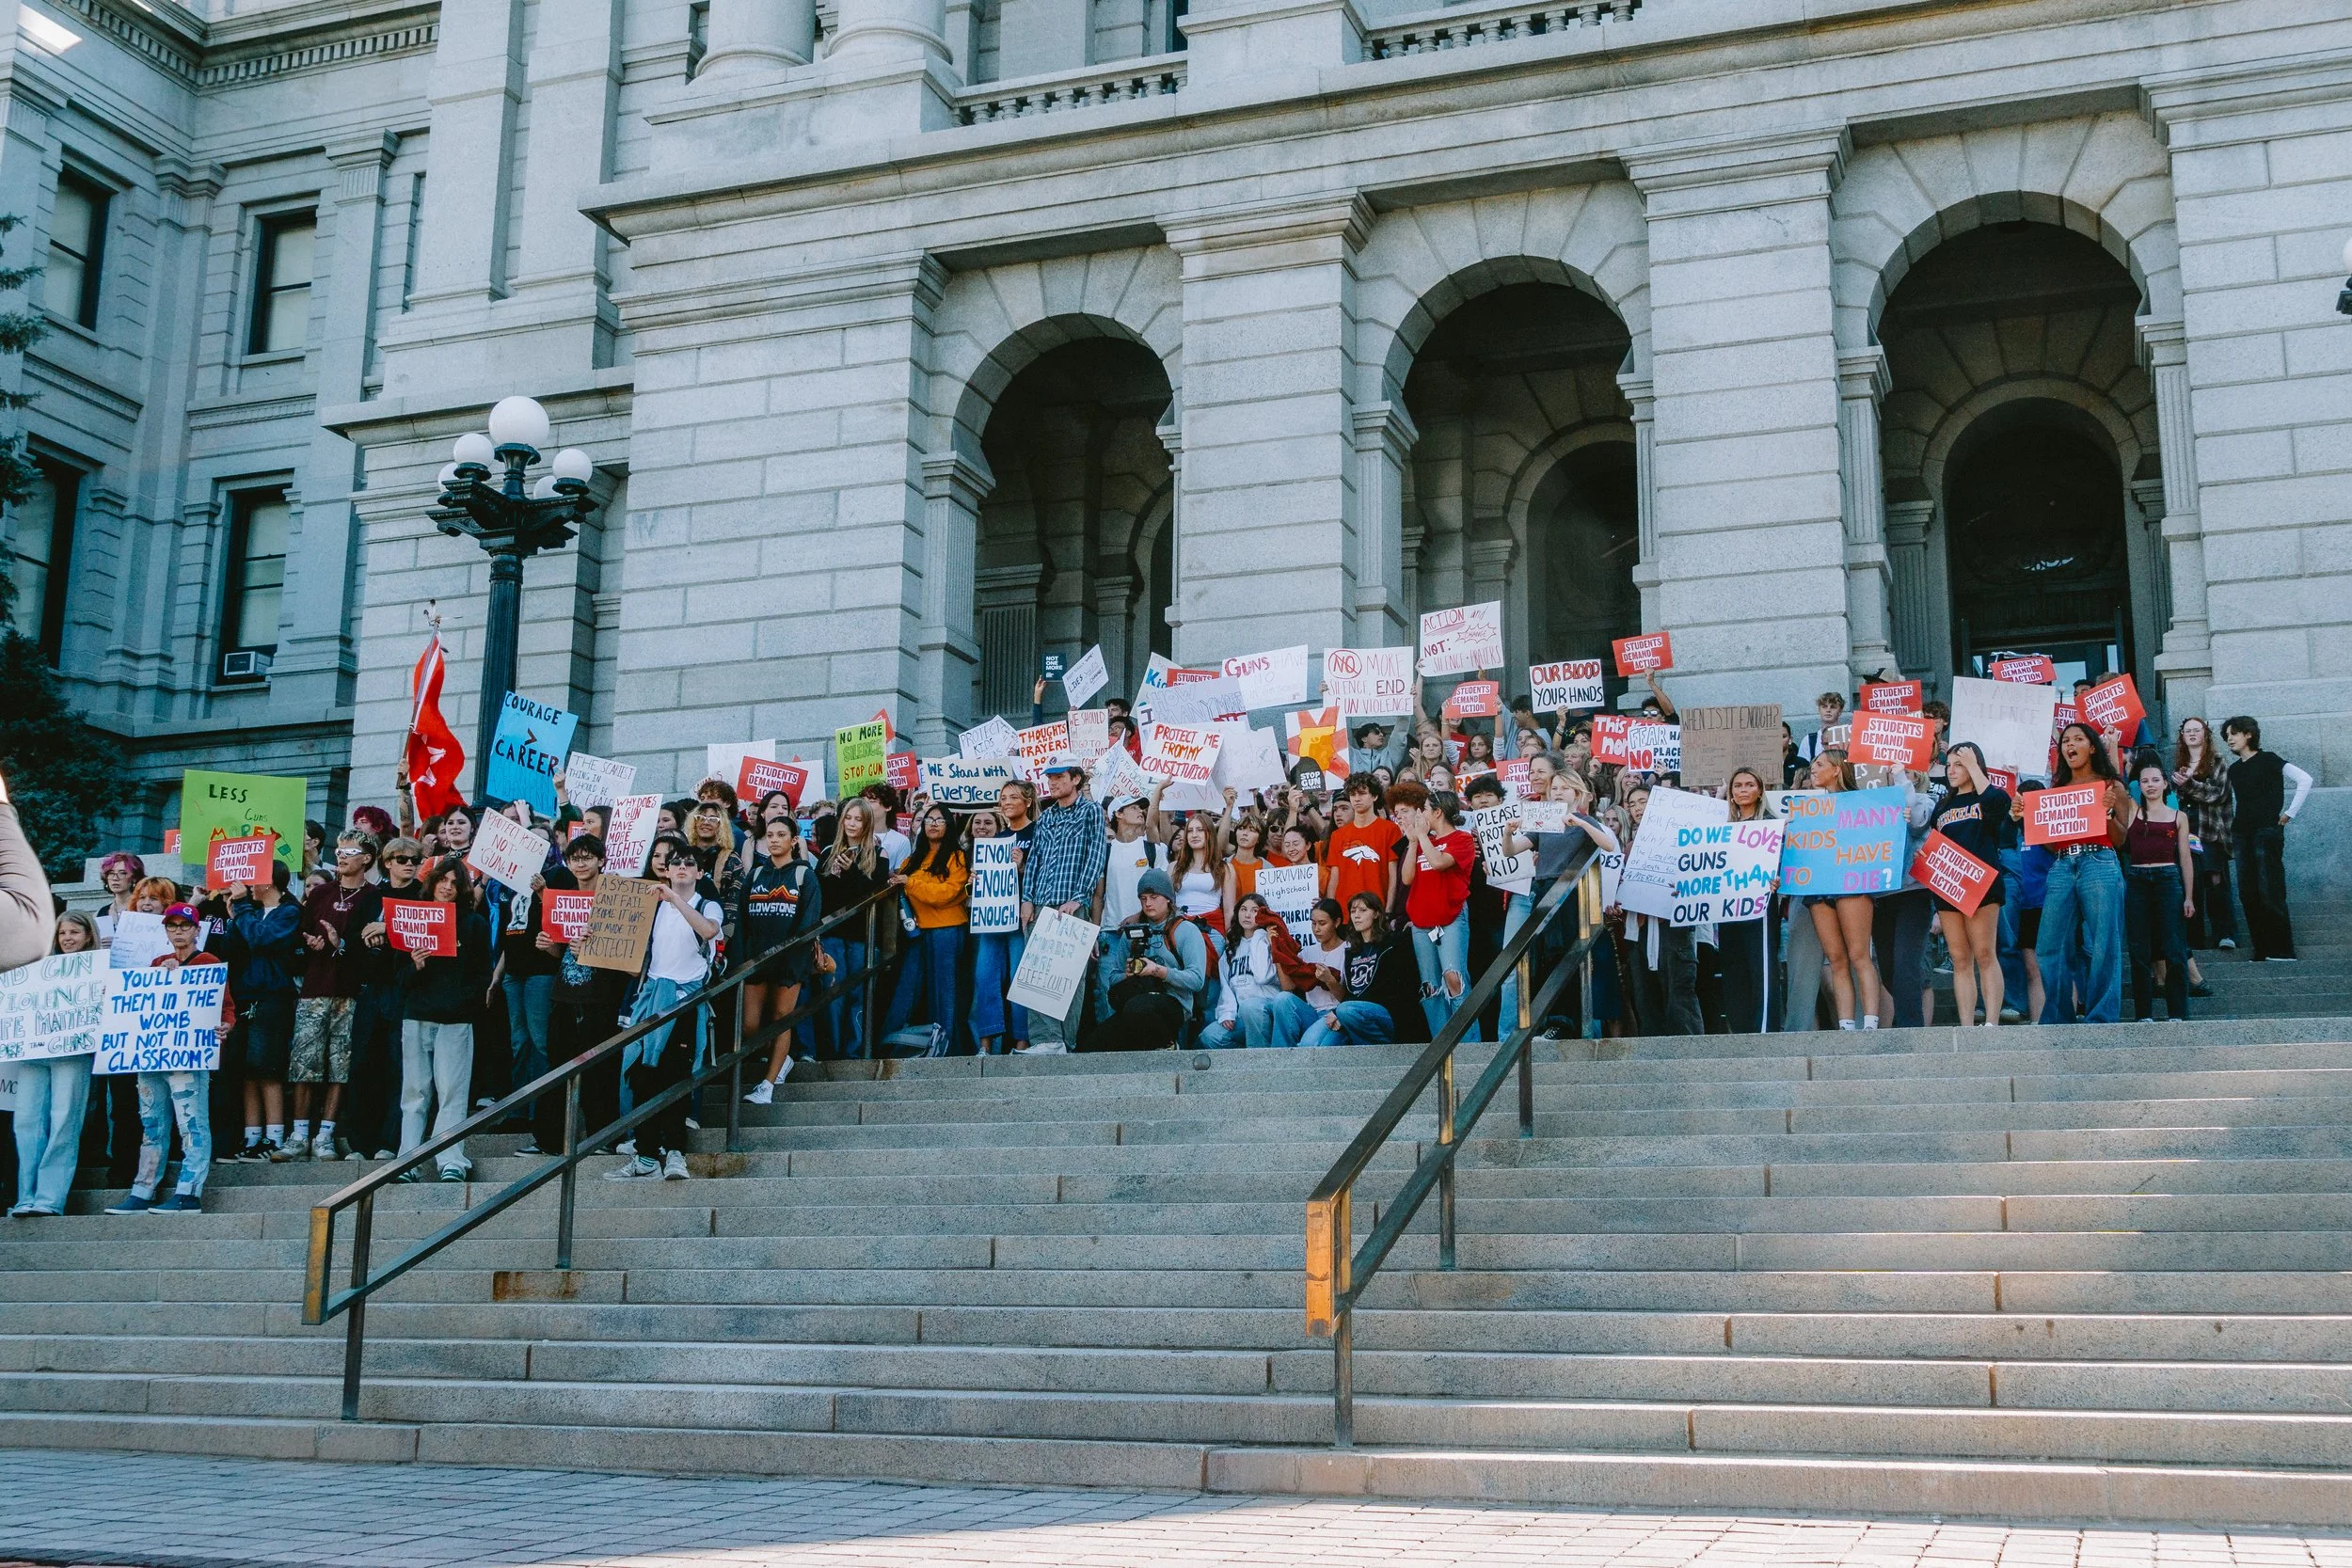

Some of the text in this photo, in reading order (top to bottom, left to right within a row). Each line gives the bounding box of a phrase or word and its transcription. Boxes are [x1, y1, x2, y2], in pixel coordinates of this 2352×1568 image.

[1424, 609, 1465, 633] ACTION
[1626, 639, 1662, 651] STUDENTS
[1367, 653, 1405, 677] MORE
[1624, 650, 1651, 661] DEMAND
[1634, 659, 1660, 670] ACTION
[2004, 659, 2042, 669] STUDENTS
[1224, 657, 1270, 678] GUNS
[1532, 661, 1600, 686] OUR BLOOD
[2002, 667, 2032, 678] DEMAND
[1376, 679, 1406, 694] END
[2014, 673, 2041, 683] ACTION
[1456, 686, 1490, 694] STUDENTS
[1534, 686, 1603, 706] YOUR HANDS
[1873, 687, 1913, 698] STUDENTS
[2085, 683, 2125, 708] STUDENTS
[505, 693, 563, 725] COURAGE
[1362, 698, 1411, 714] VIOLENCE
[1453, 695, 1479, 705] DEMAND
[1461, 704, 1485, 712] ACTION
[1870, 698, 1900, 709] DEMAND
[1081, 711, 1104, 725] SHOULD
[1681, 705, 1780, 731] WHEN IS IT ENOUGH?
[2087, 700, 2114, 721] DEMAND
[2098, 708, 2126, 727] ACTION
[840, 725, 882, 744] NO MORE
[960, 720, 1002, 747] PROTECT
[1019, 723, 1066, 744] THOUGHTS
[1595, 717, 1625, 735] This
[1869, 720, 1923, 736] STUDENTS
[1154, 723, 1220, 749] PROTECT ME
[1629, 726, 1667, 749] FEAR
[1862, 733, 1903, 747] DEMAND
[973, 737, 994, 755] KIDS
[1020, 738, 1068, 758] PRAYERS
[1161, 741, 1186, 761] FROM
[1875, 748, 1911, 763] ACTION
[495, 738, 560, 777] CAREER
[573, 755, 599, 771] THE
[1629, 747, 1681, 770] NO PLACE
[569, 768, 601, 783] THING IN
[755, 765, 798, 784] STUDENTS
[844, 765, 865, 781] STOP
[867, 762, 882, 777] GUN
[928, 763, 1009, 779] WE Stand with
[1141, 755, 1212, 781] CONSTITUTION
[1300, 771, 1321, 780] STOP
[575, 781, 596, 793] SHOULD
[748, 774, 782, 790] DEMAND
[1301, 777, 1321, 787] GUN
[209, 784, 247, 803] LESS
[617, 798, 636, 807] WHY
[2041, 791, 2094, 809] STUDENTS
[625, 808, 642, 820] GUN
[1476, 804, 1521, 827] PLEASE
[1788, 797, 1902, 829] HOW MANY
[2036, 807, 2077, 824] DEMAND
[487, 812, 520, 840] PROTECT
[610, 820, 634, 831] HAVE
[2051, 819, 2088, 836] ACTION
[492, 834, 516, 857] NOT
[608, 831, 630, 844] MORE
[1678, 825, 1782, 853] DO WE LOVE
[220, 842, 265, 856] STUDENTS
[605, 839, 646, 857] RIGHTS
[1786, 830, 1893, 865] KIDS HAVE
[215, 855, 247, 869] DEMAND
[628, 857, 641, 869] ME
[1490, 857, 1519, 878] KID
[1678, 851, 1727, 872] GUNS
[1928, 853, 1963, 885] DEMAND
[1938, 844, 1984, 881] STUDENTS
[225, 867, 254, 881] ACTION
[600, 877, 607, 890] A
[1259, 865, 1314, 885] SURVIVING
[1675, 863, 1776, 899] MORE THAN
[1784, 866, 1893, 892] TO DIE?
[1931, 874, 1964, 902] ACTION
[622, 895, 644, 909] FAIL
[1674, 893, 1770, 924] OUR KIDS?
[396, 907, 444, 922] STUDENTS
[553, 911, 589, 924] DEMAND
[590, 907, 646, 923] PEOPLE IT WAS
[393, 919, 426, 935] DEMAND
[605, 923, 623, 934] MADE
[628, 925, 638, 935] TO
[1047, 912, 1089, 946] MAKE
[405, 935, 437, 949] ACTION
[583, 934, 636, 958] PROTECT!
[1029, 933, 1076, 958] MURDER
[41, 951, 92, 981] GUN
[1024, 952, 1053, 973] MORE
[122, 969, 173, 991] YOU'LL
[111, 989, 218, 1014] THEM THE
[140, 1010, 191, 1031] WOMB
[48, 1028, 96, 1054] GUNS
[101, 1028, 219, 1052] BUT NOT THE
[108, 1047, 215, 1072] CLASSROOM?
